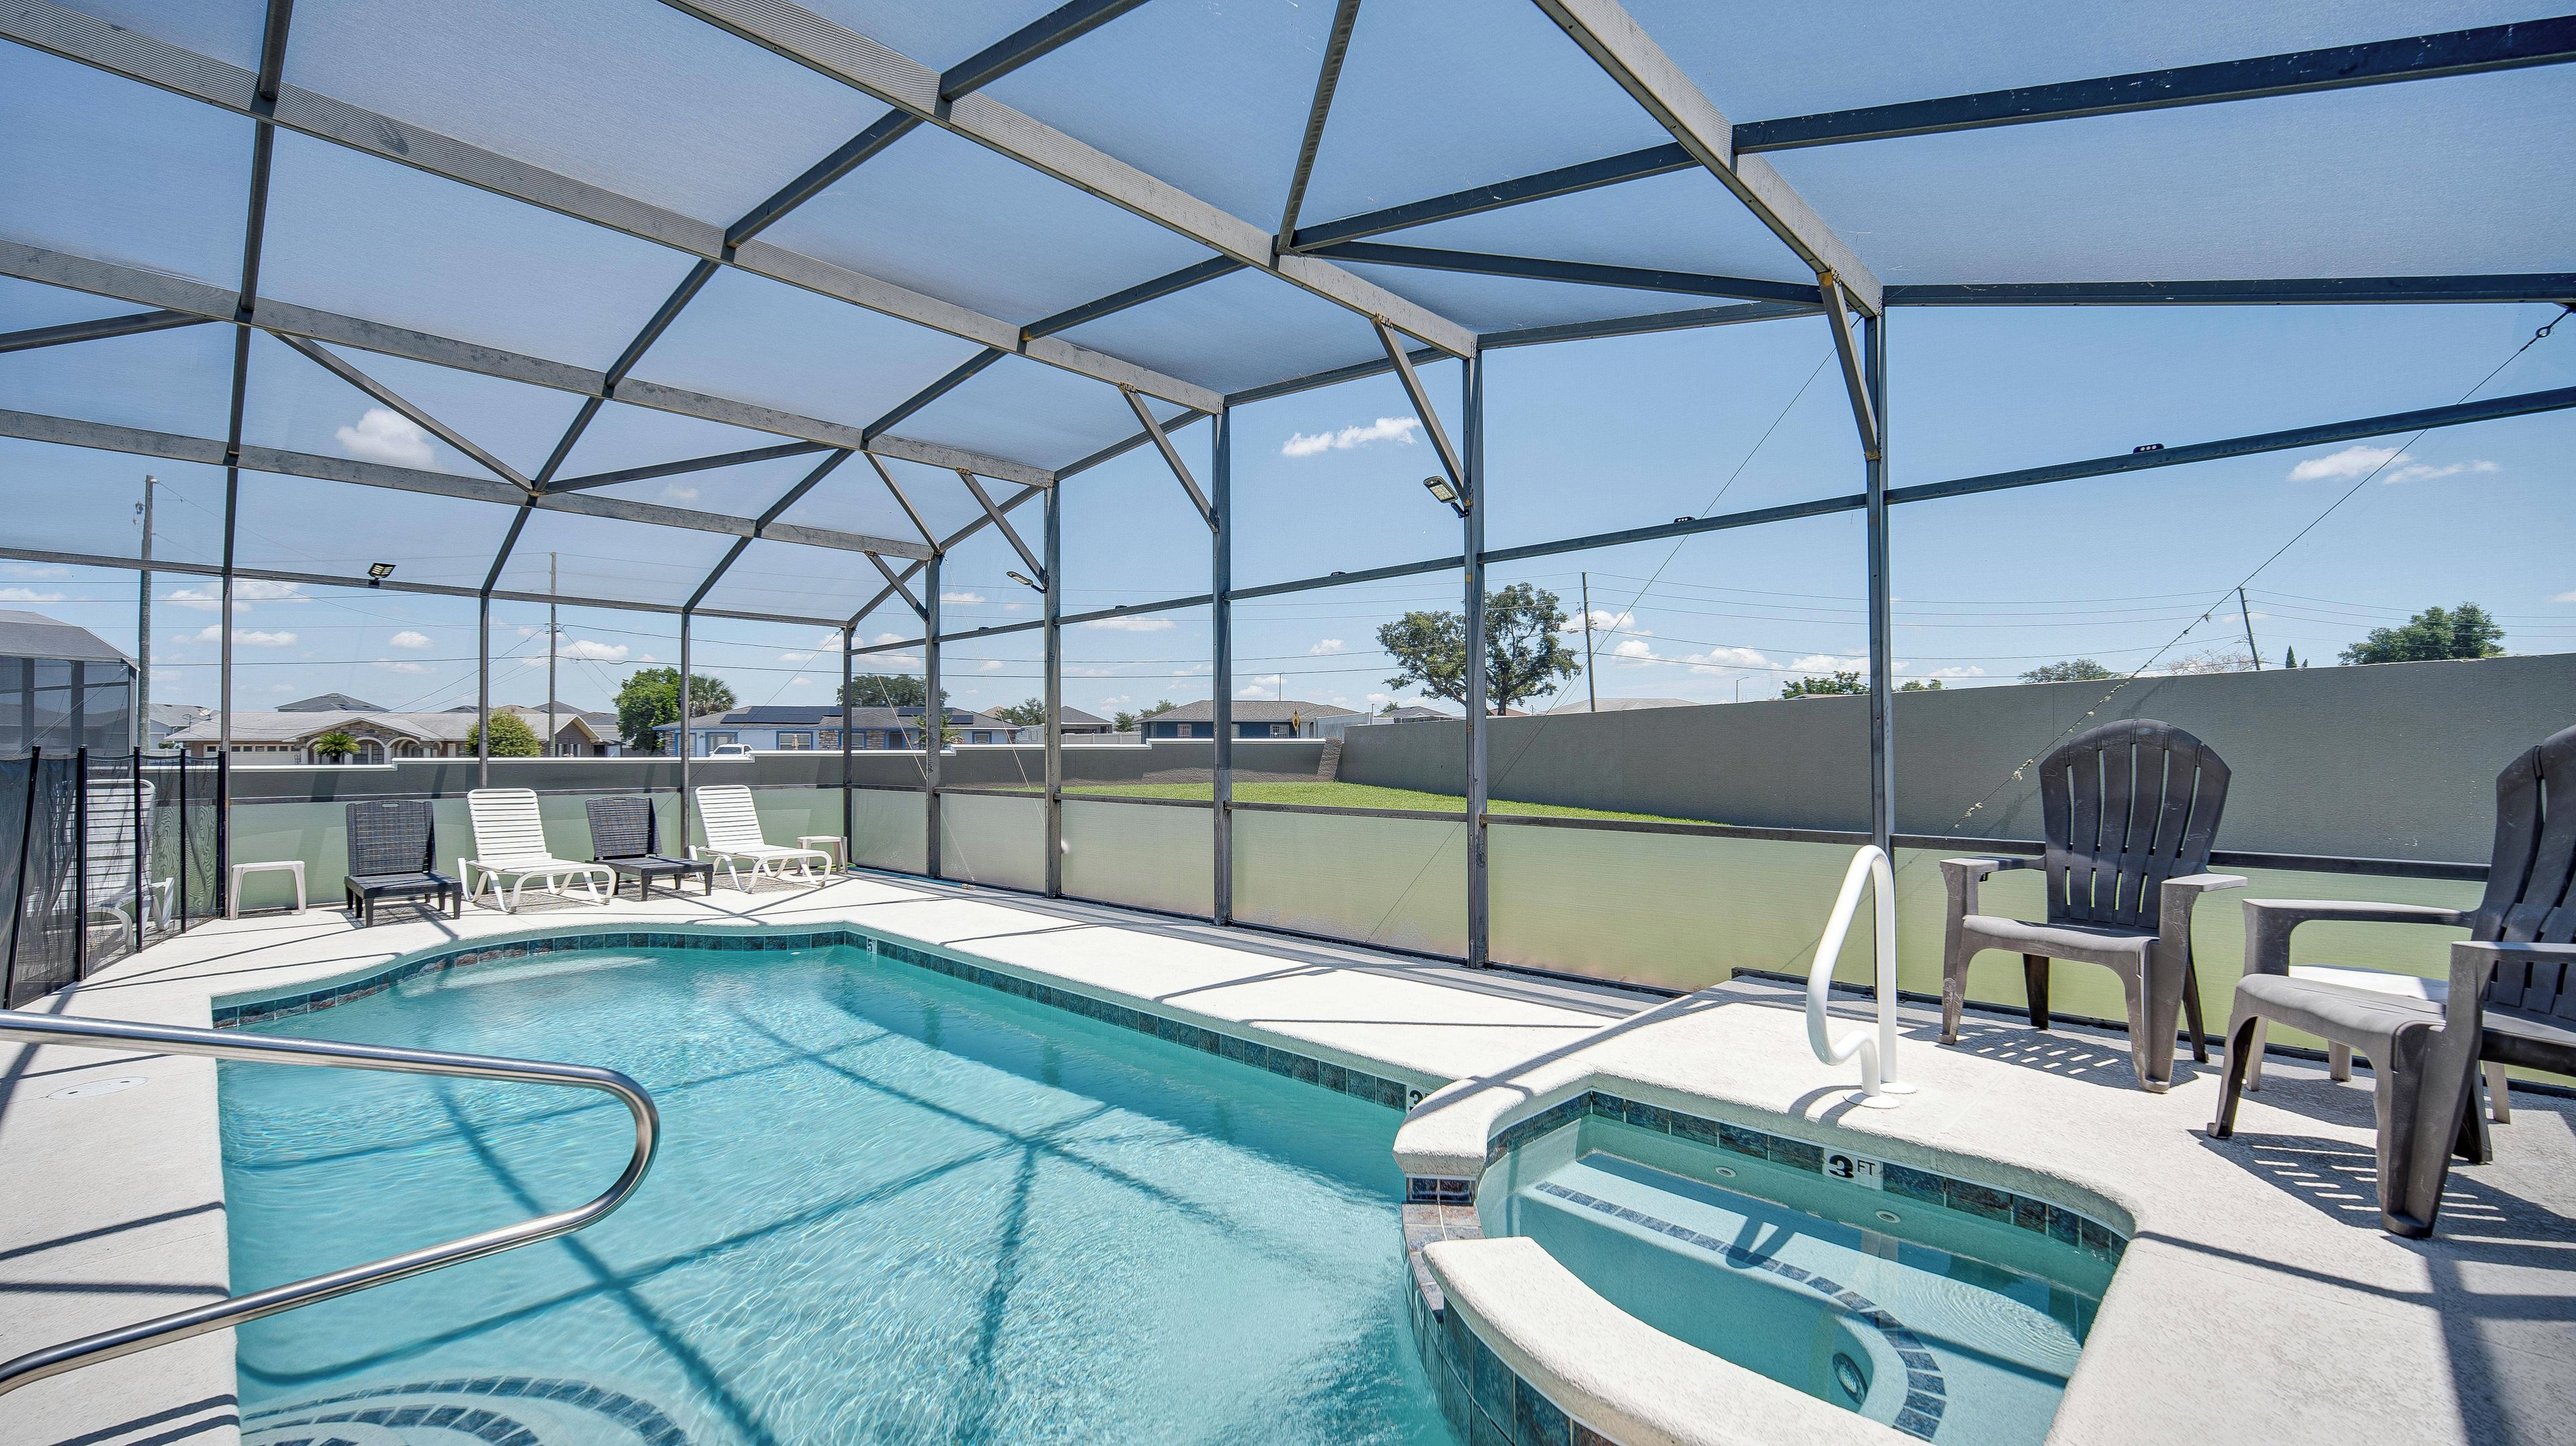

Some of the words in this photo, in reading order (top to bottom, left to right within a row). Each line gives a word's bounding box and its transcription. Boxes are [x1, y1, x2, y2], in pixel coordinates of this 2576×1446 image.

[867, 938, 873, 952] 5
[1829, 1154, 1854, 1178] 3
[1857, 1159, 1876, 1176] FT
